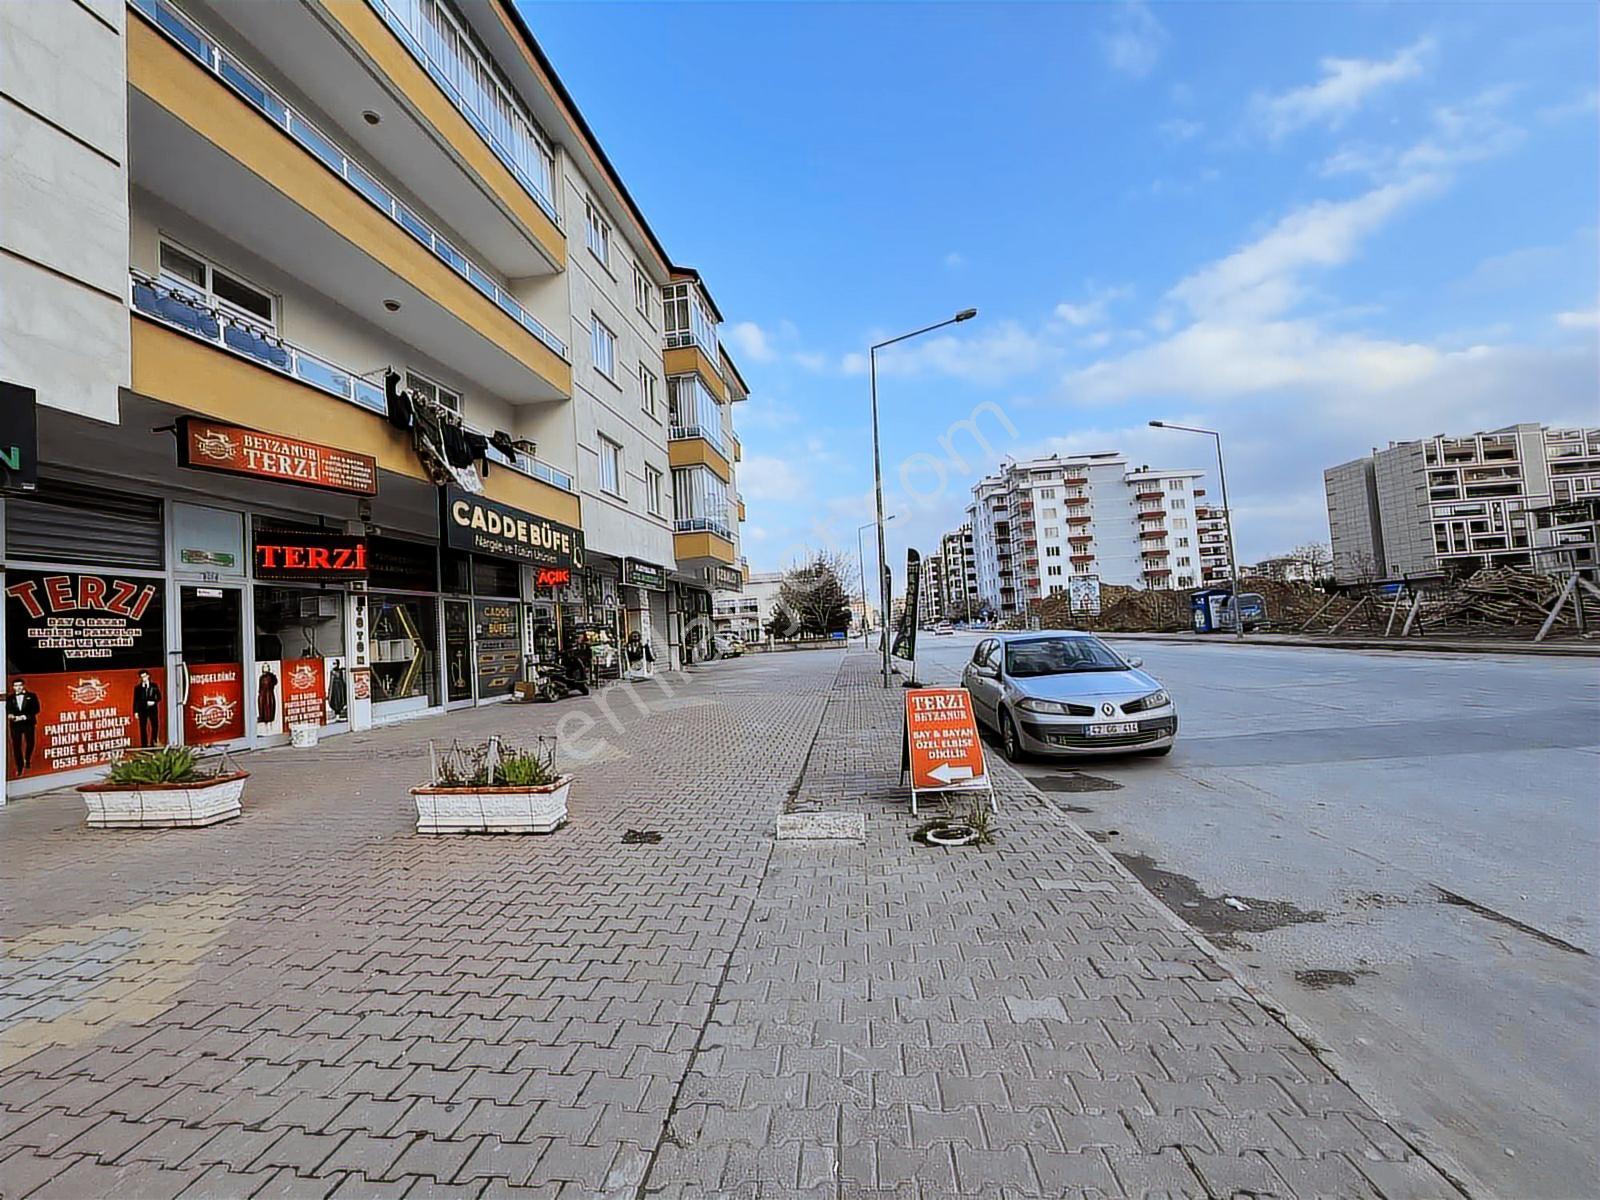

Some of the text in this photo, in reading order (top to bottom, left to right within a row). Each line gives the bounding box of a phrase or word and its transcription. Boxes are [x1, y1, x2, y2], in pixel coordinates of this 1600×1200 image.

[244, 435, 316, 460] BEYZANUR
[452, 500, 570, 554] CADDE BÜFE
[256, 543, 367, 570] TERZİ
[538, 569, 570, 585] AÇIK
[5, 575, 156, 621] TERZİ
[60, 711, 77, 722] BAY
[89, 707, 117, 719] BAYAN
[44, 717, 131, 735] PANTOLON GÖMLEK
[913, 729, 931, 739] BAY
[942, 727, 974, 738] BAYAN
[51, 733, 79, 747] DİKİM
[81, 731, 94, 742] VE
[916, 739, 940, 750] ÖZEL
[44, 745, 76, 759] PERDE
